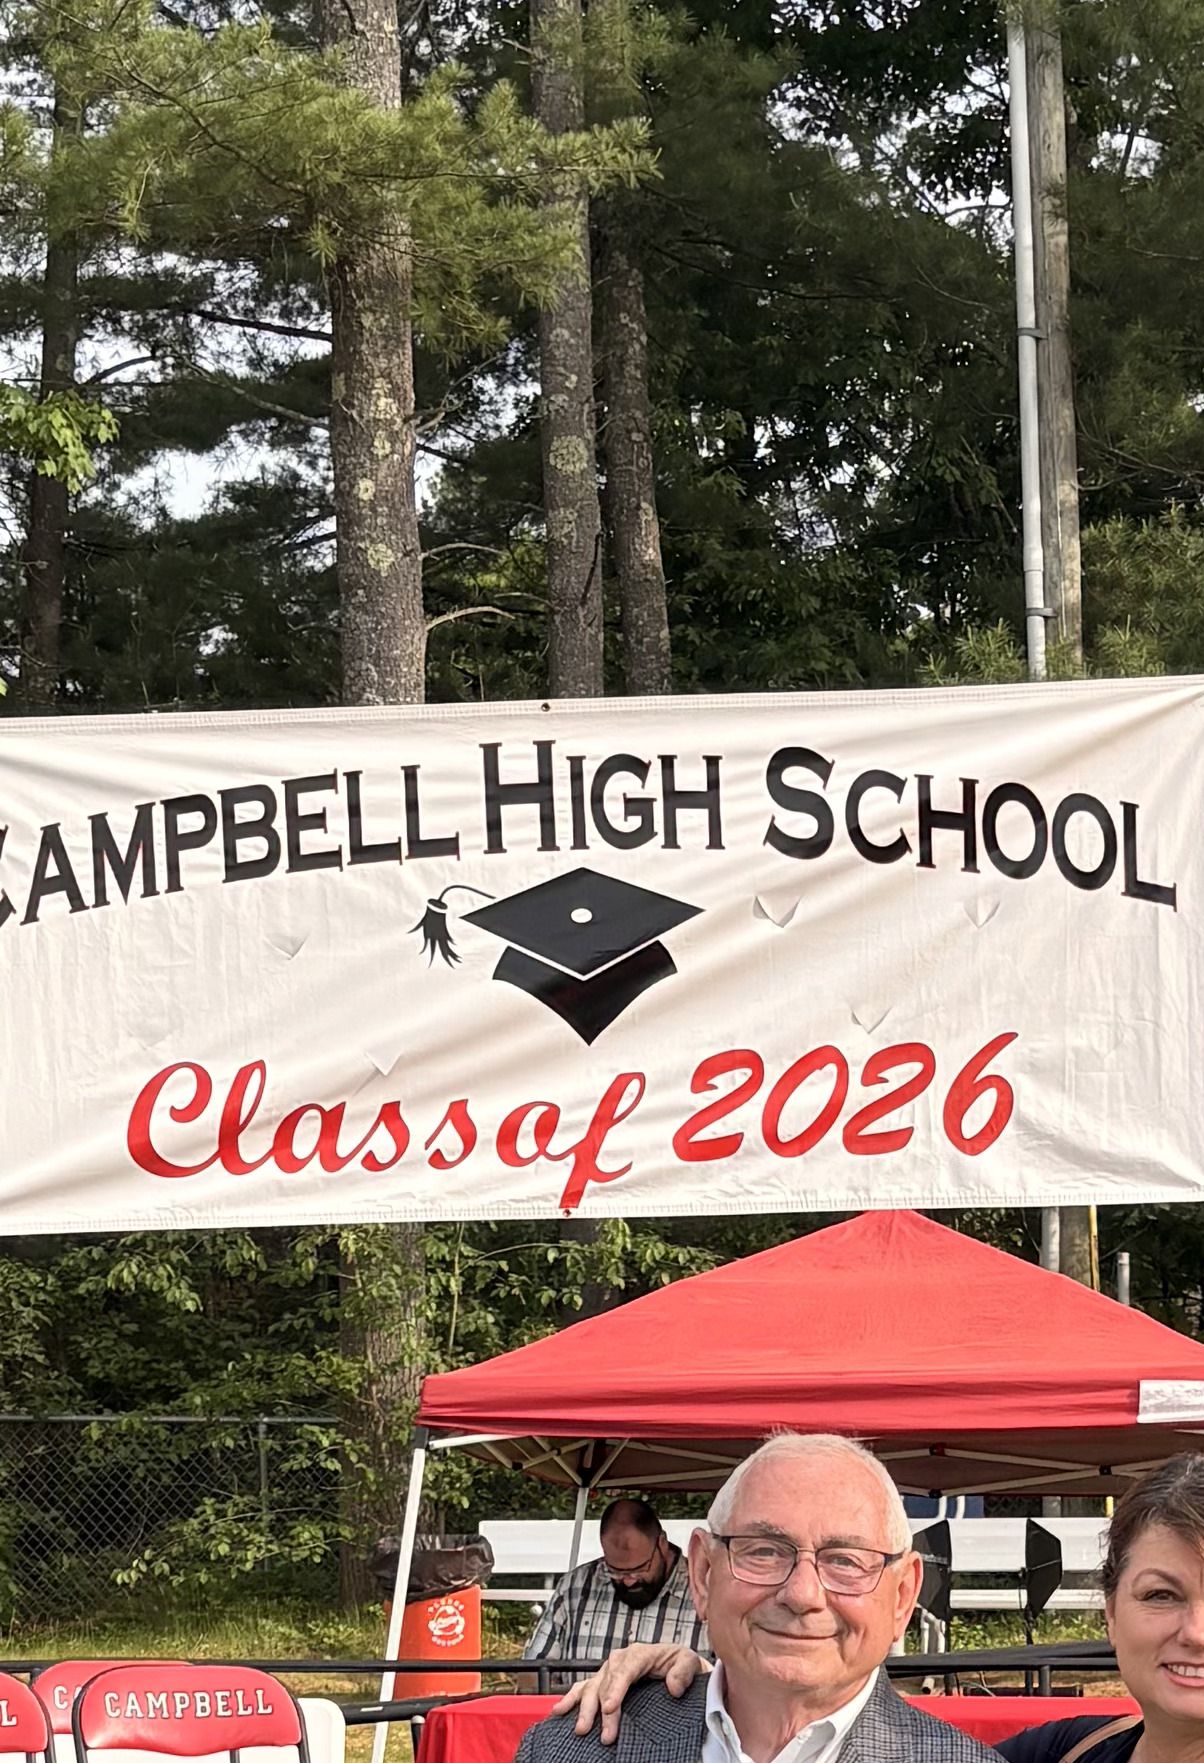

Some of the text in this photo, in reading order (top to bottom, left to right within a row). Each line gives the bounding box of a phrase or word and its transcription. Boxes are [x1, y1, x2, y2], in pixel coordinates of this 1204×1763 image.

[0, 740, 1178, 928] AMPBELL HIGH SCHOOL
[672, 1032, 1019, 1162] 2026
[103, 1688, 274, 1719] CAMPBELL
